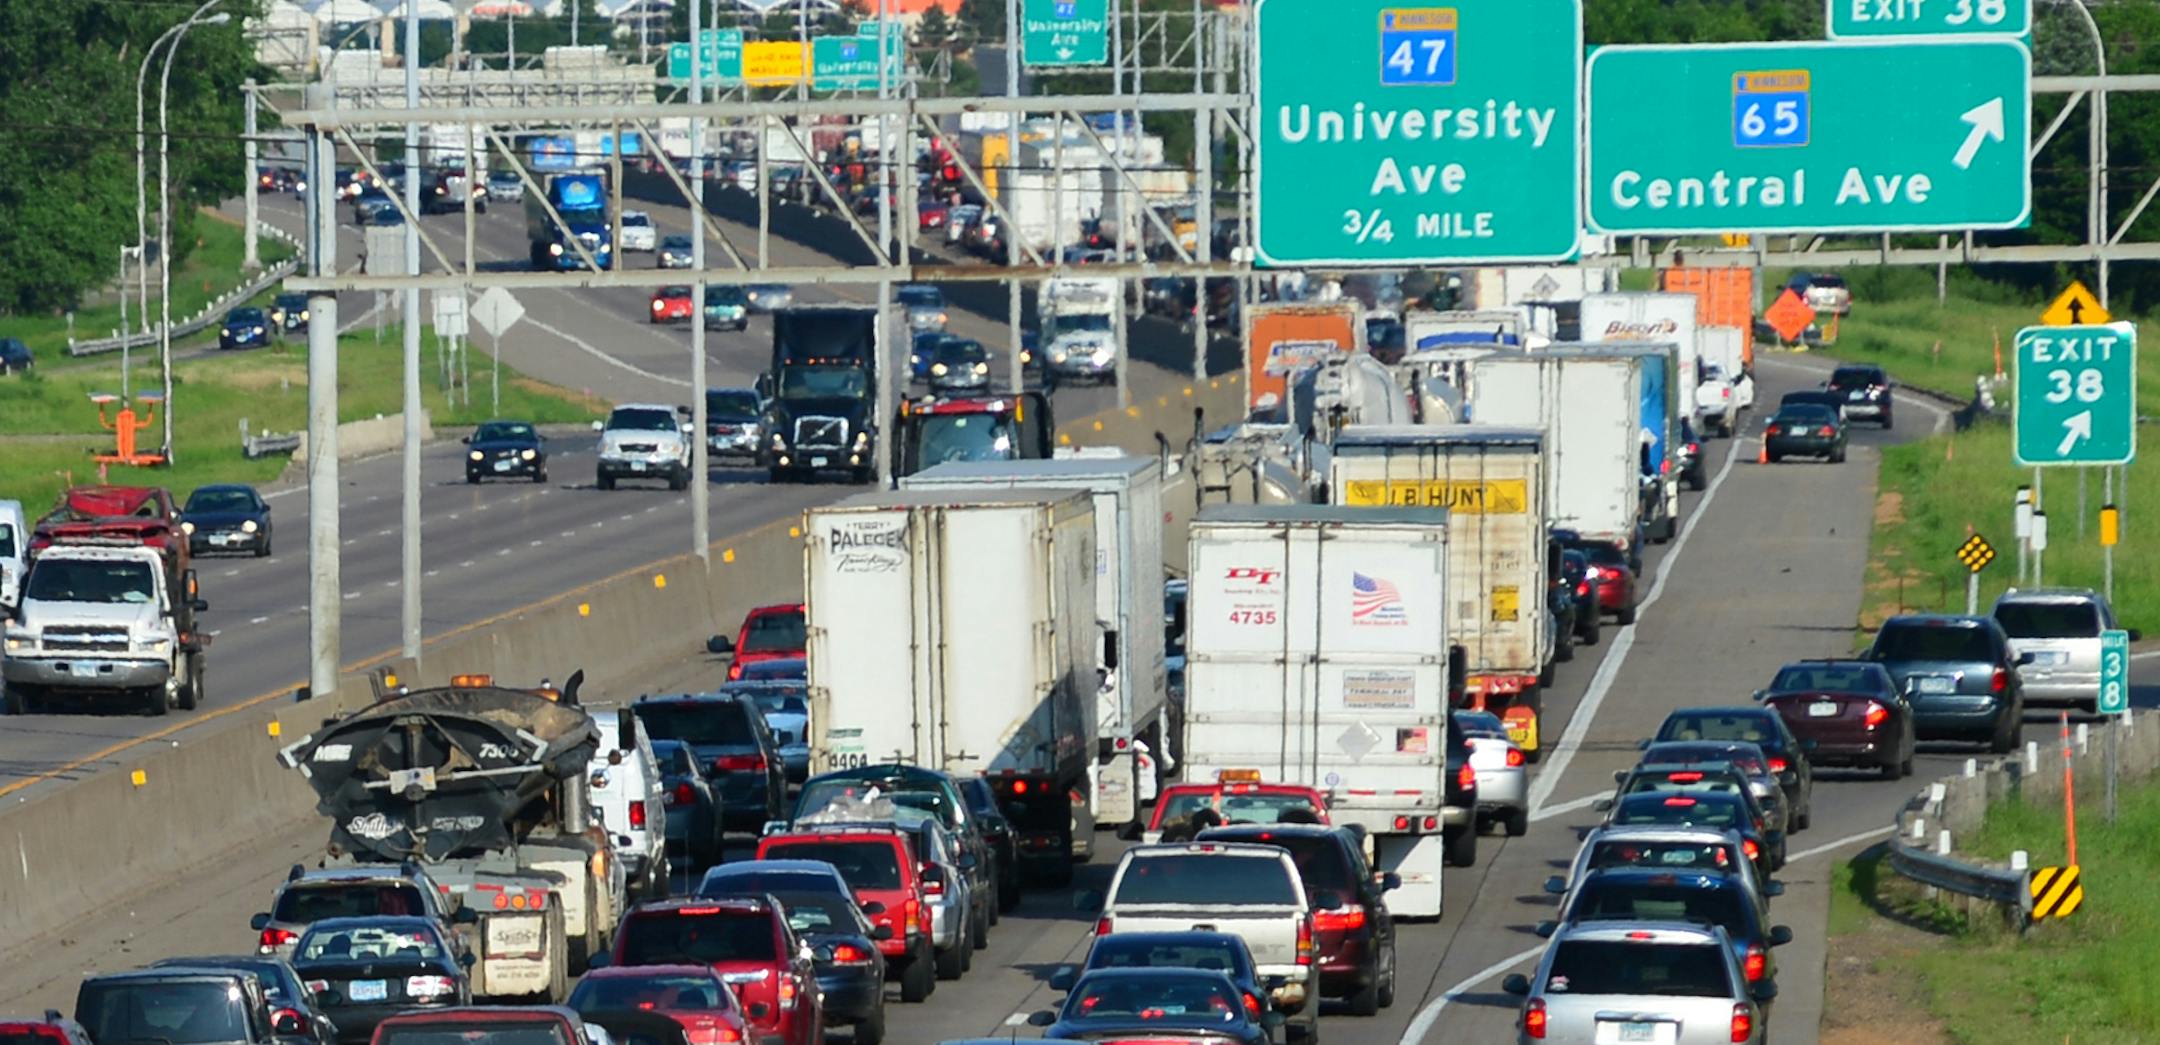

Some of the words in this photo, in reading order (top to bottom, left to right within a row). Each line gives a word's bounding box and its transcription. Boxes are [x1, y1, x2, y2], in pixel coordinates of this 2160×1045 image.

[1027, 19, 1102, 33] University
[1852, 0, 1925, 21] EXIT
[1944, 0, 2006, 25] 38
[1387, 39, 1446, 76] 47
[1279, 99, 1556, 147] University
[1740, 100, 1800, 137] 65
[1370, 158, 1466, 195] Ave
[1611, 169, 1804, 207] Central
[1835, 168, 1932, 204] Ave
[1343, 209, 1394, 243] 3/4
[1416, 212, 1494, 237] MILE
[2032, 337, 2118, 362] EXIT
[2045, 367, 2104, 403] 38
[1428, 487, 1487, 507] HUNT
[830, 526, 911, 554] PALECEK
[1230, 611, 1276, 625] 4735
